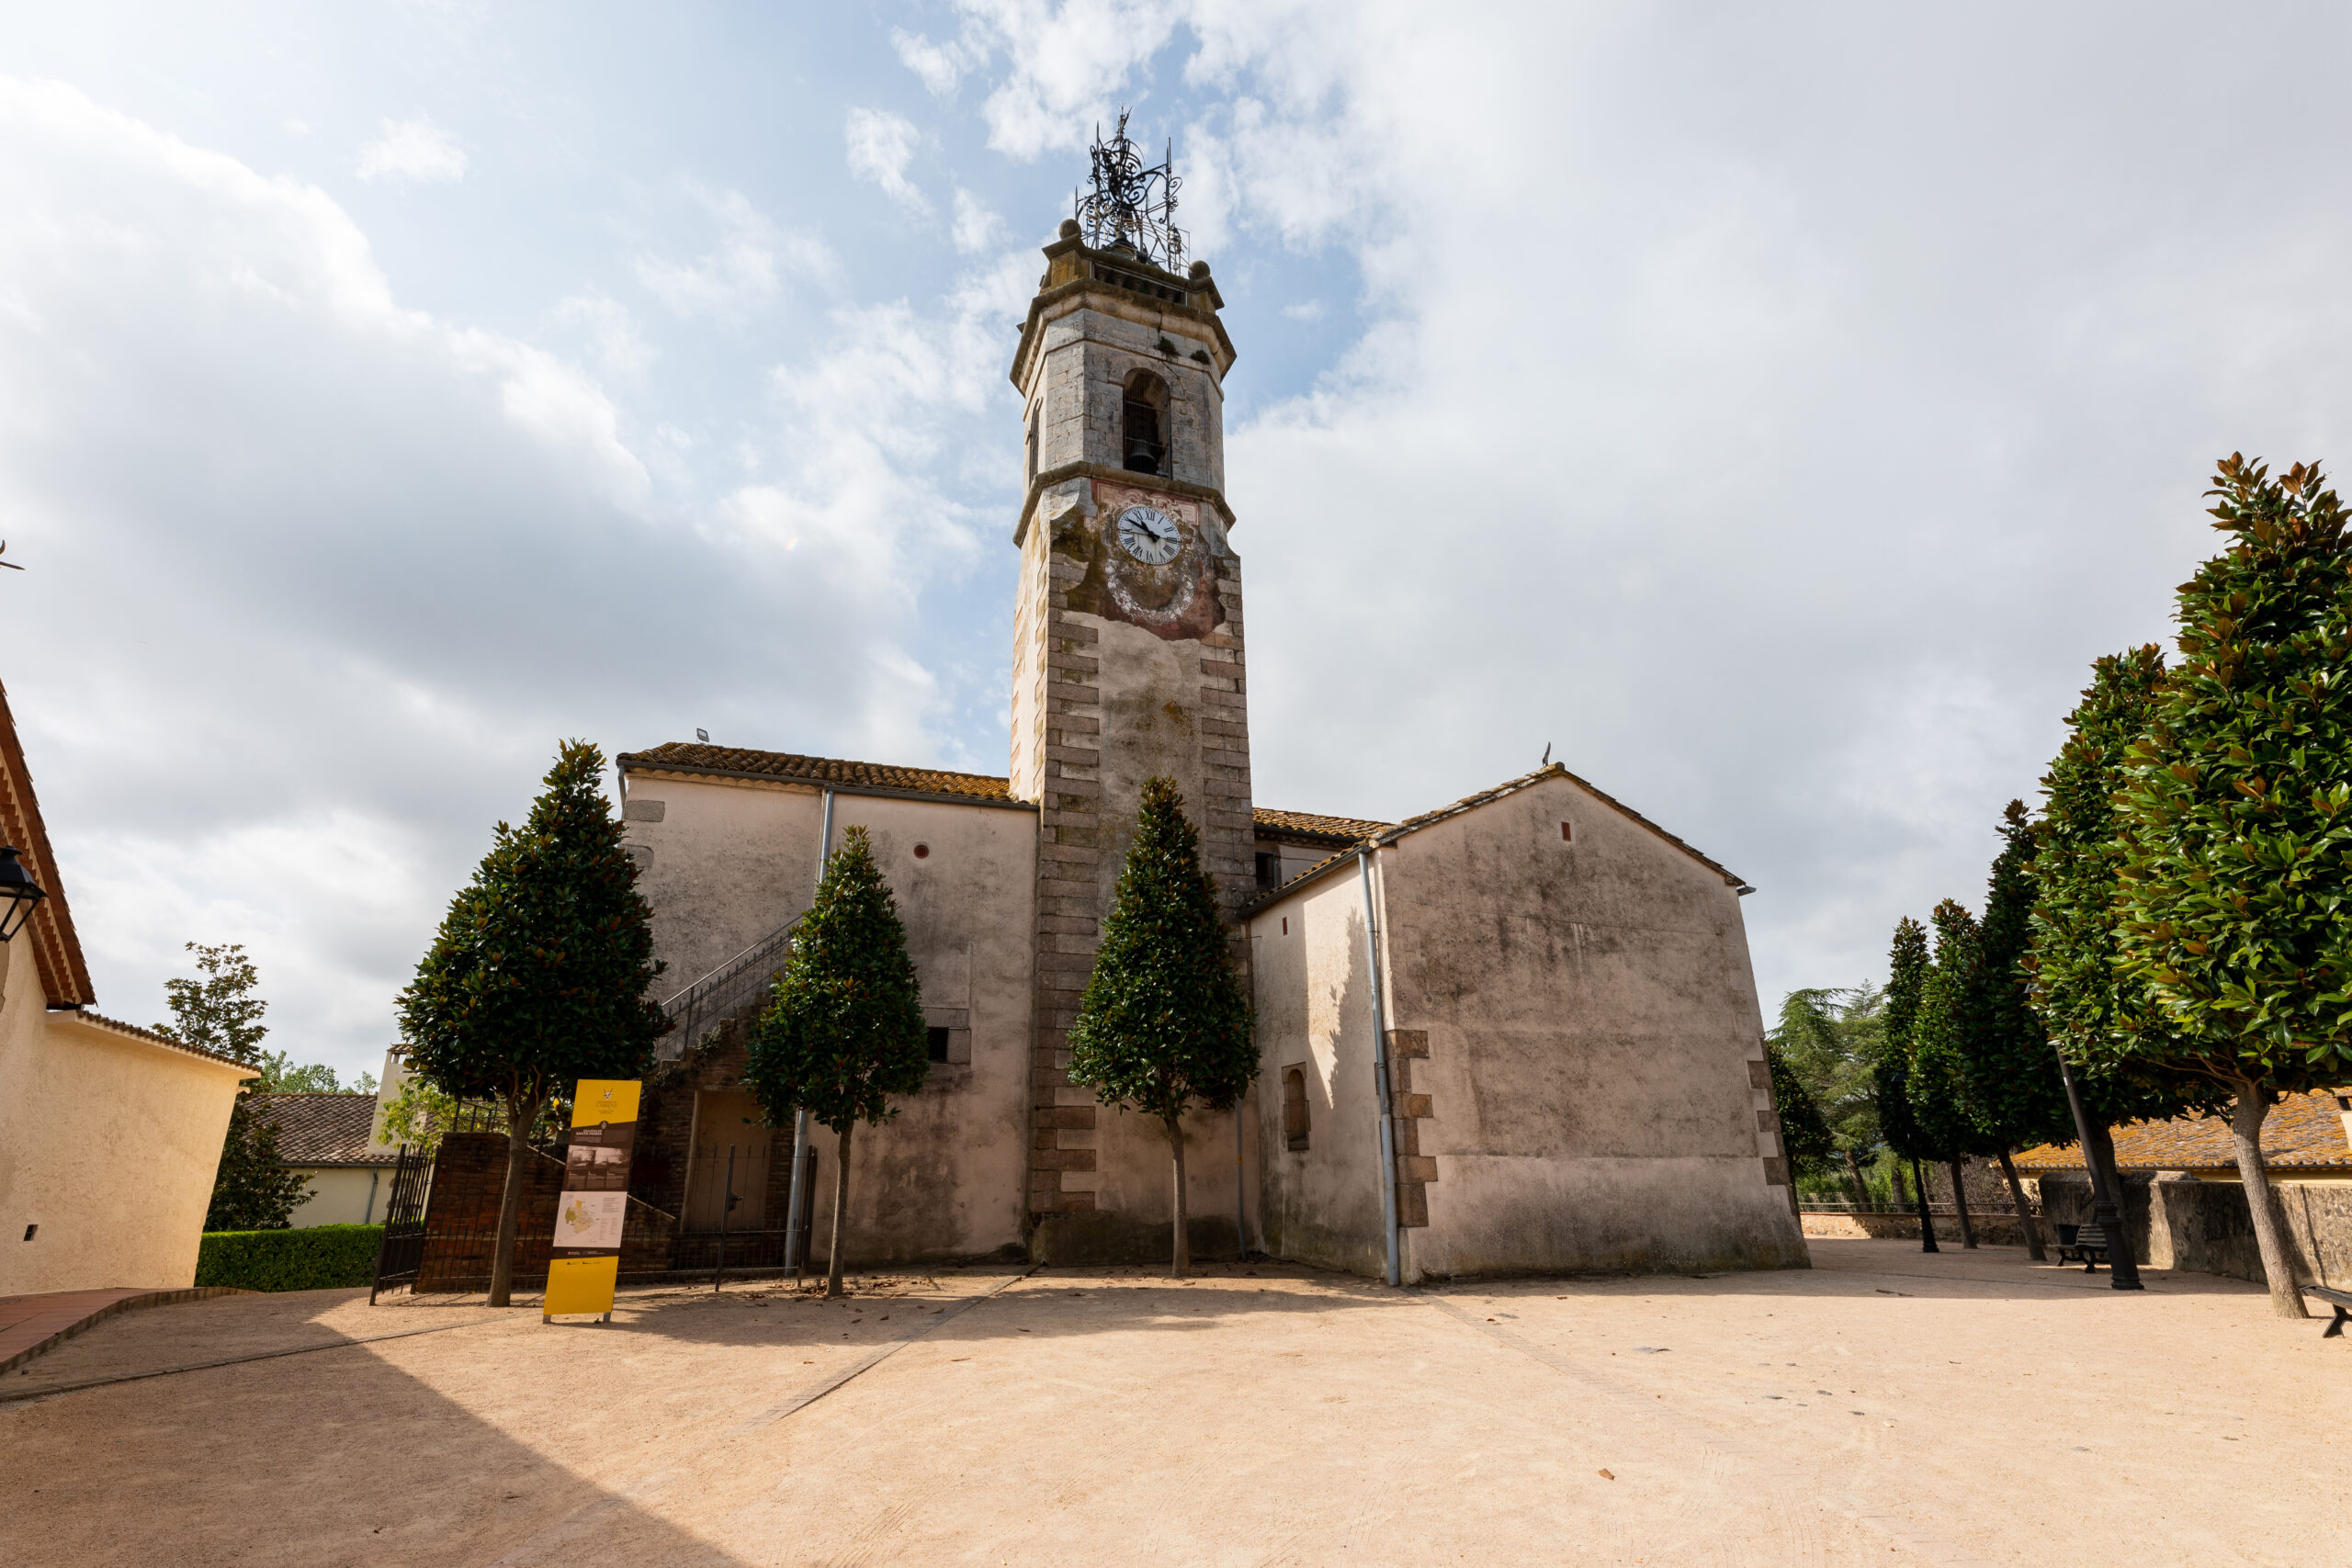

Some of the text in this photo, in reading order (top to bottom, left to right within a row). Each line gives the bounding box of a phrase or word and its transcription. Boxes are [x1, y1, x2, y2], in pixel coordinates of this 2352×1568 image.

[1133, 511, 1143, 522] XI
[1146, 510, 1155, 521] XII
[1158, 515, 1165, 525] I
[1124, 536, 1136, 548] VIII
[1167, 536, 1178, 545] III
[1133, 546, 1143, 558] VII
[1146, 550, 1154, 561] VI
[1159, 550, 1166, 561] V
